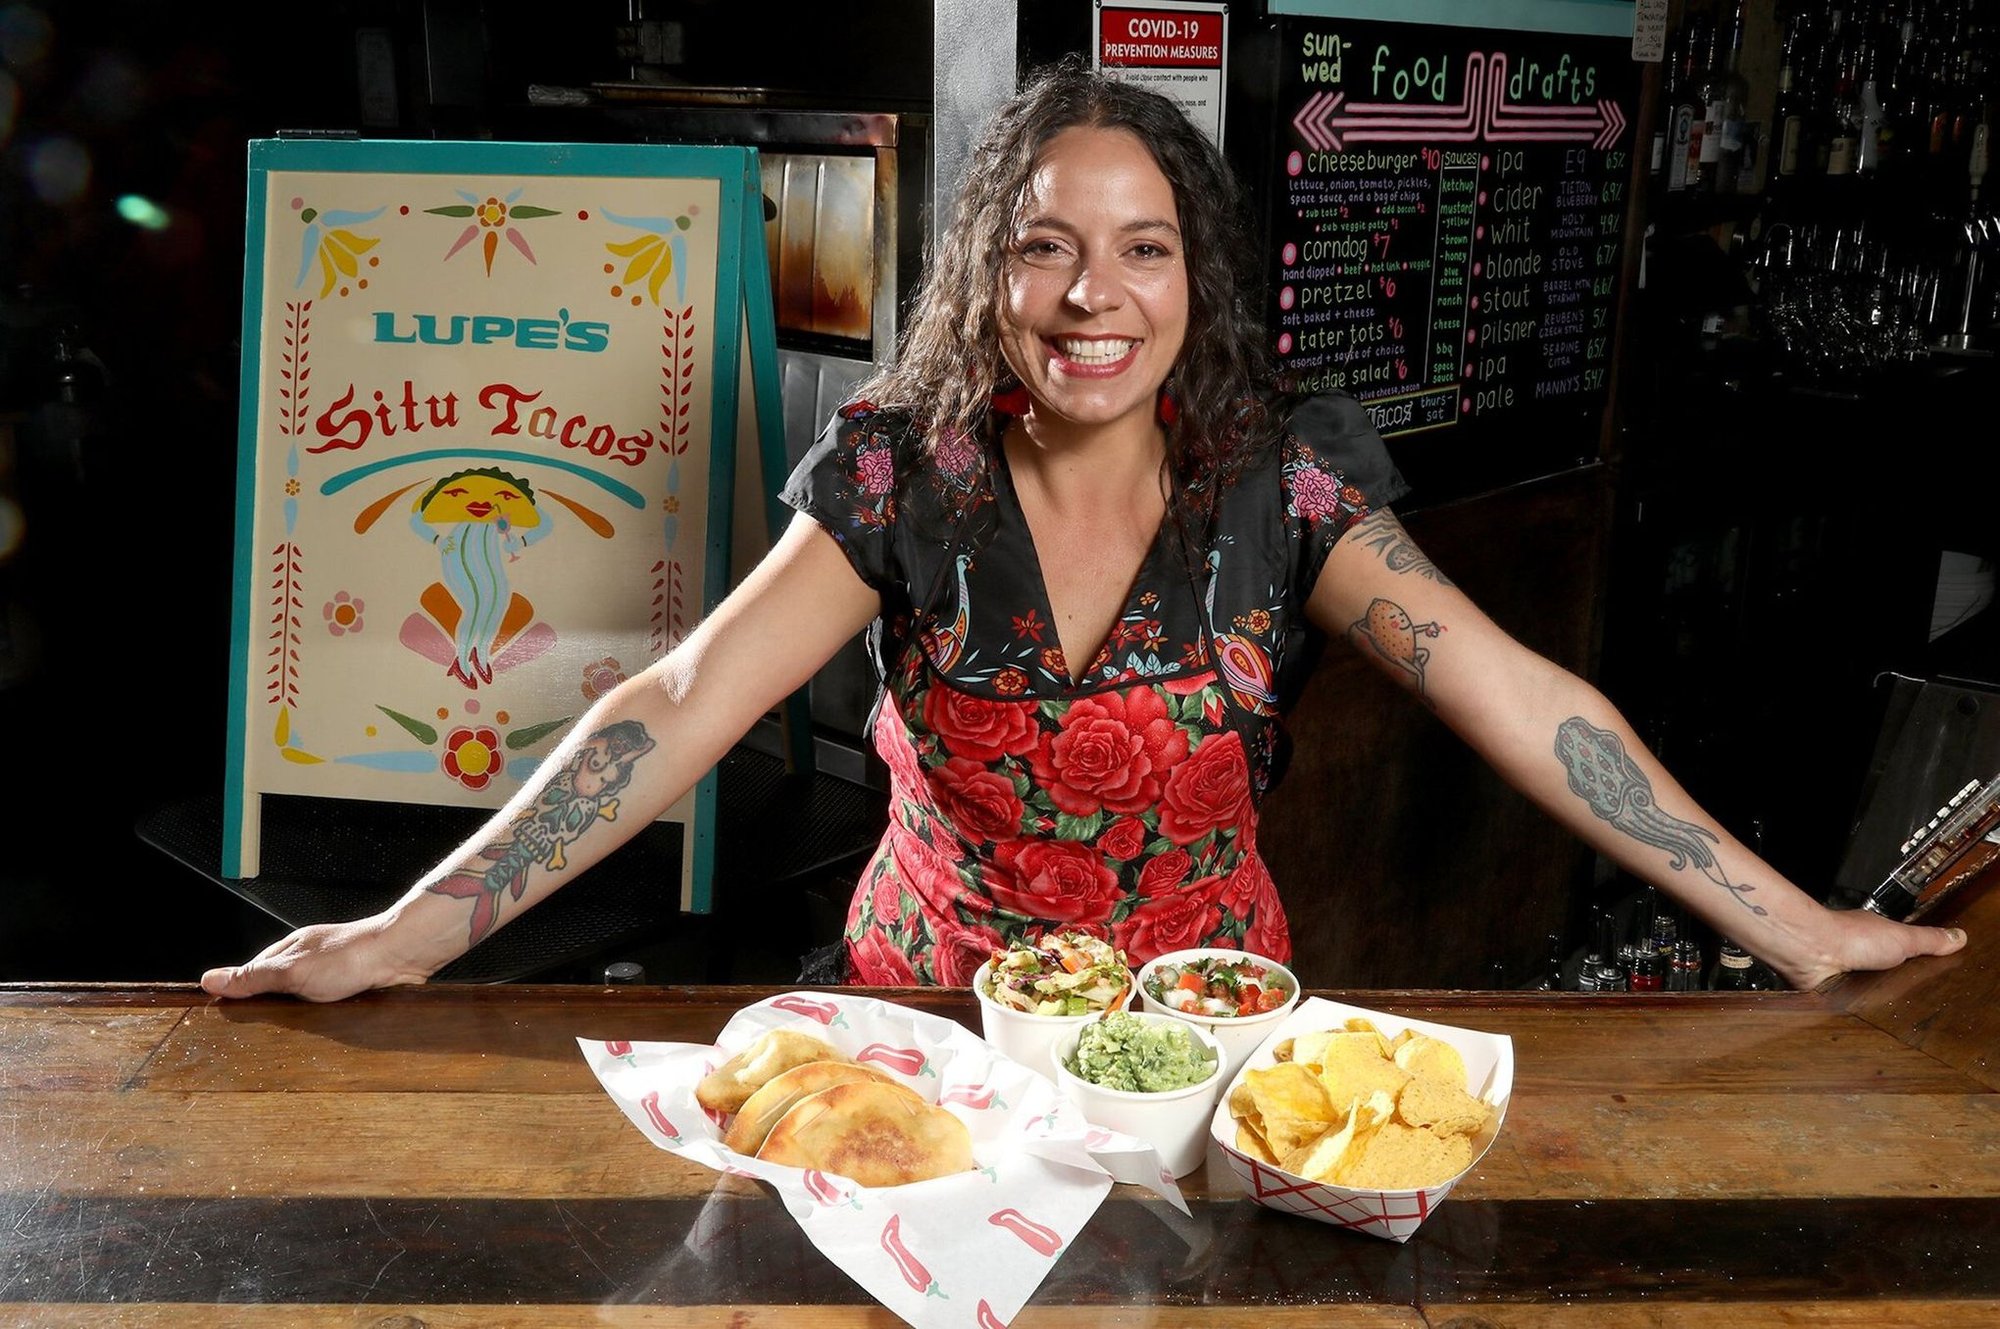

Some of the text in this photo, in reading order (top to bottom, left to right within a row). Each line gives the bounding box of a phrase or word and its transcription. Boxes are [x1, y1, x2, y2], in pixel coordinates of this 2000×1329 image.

[1128, 18, 1199, 39] COVID-19
[1105, 43, 1218, 59] PREVENTION MEASURES
[1303, 32, 1351, 57] sun-
[1302, 57, 1342, 83] wed
[1372, 45, 1447, 102] food
[1509, 54, 1596, 104] drafts
[1307, 147, 1441, 174] cheeseburger $10
[1496, 149, 1524, 179] ipa
[1348, 192, 1364, 202] and
[1441, 178, 1475, 194] ketchup
[1493, 182, 1543, 213] cider
[1441, 200, 1474, 214] mustard
[1561, 213, 1586, 226] HOLY
[1491, 216, 1531, 245] whit
[1550, 226, 1594, 240] MOUNTAIN
[1303, 232, 1391, 262] corndog $7
[1559, 245, 1579, 257] OLD
[1282, 266, 1305, 281] hand
[1306, 263, 1335, 280] dipped
[1343, 261, 1362, 276] beef
[1486, 249, 1542, 280] blonde
[1552, 257, 1584, 272] STOVE
[1301, 276, 1396, 310] pretzel $6
[1437, 293, 1463, 307] ranch
[1482, 283, 1531, 314] stout
[1282, 312, 1301, 326] soft
[1304, 309, 1331, 324] baked
[1343, 307, 1376, 320] cheese
[1433, 318, 1461, 330] cheese
[1592, 305, 1608, 329] 5%
[372, 308, 610, 353] LUPE'S
[1299, 326, 1344, 352] tater
[1349, 320, 1384, 346] tots
[1480, 319, 1537, 348] pilsner
[1436, 342, 1453, 358] bbq
[1351, 360, 1390, 385] salad
[1394, 358, 1408, 380] $6
[1479, 356, 1507, 382] ipa
[1476, 384, 1514, 416] pale
[305, 380, 655, 467] Situ Tacos
[1425, 406, 1444, 422] sat
